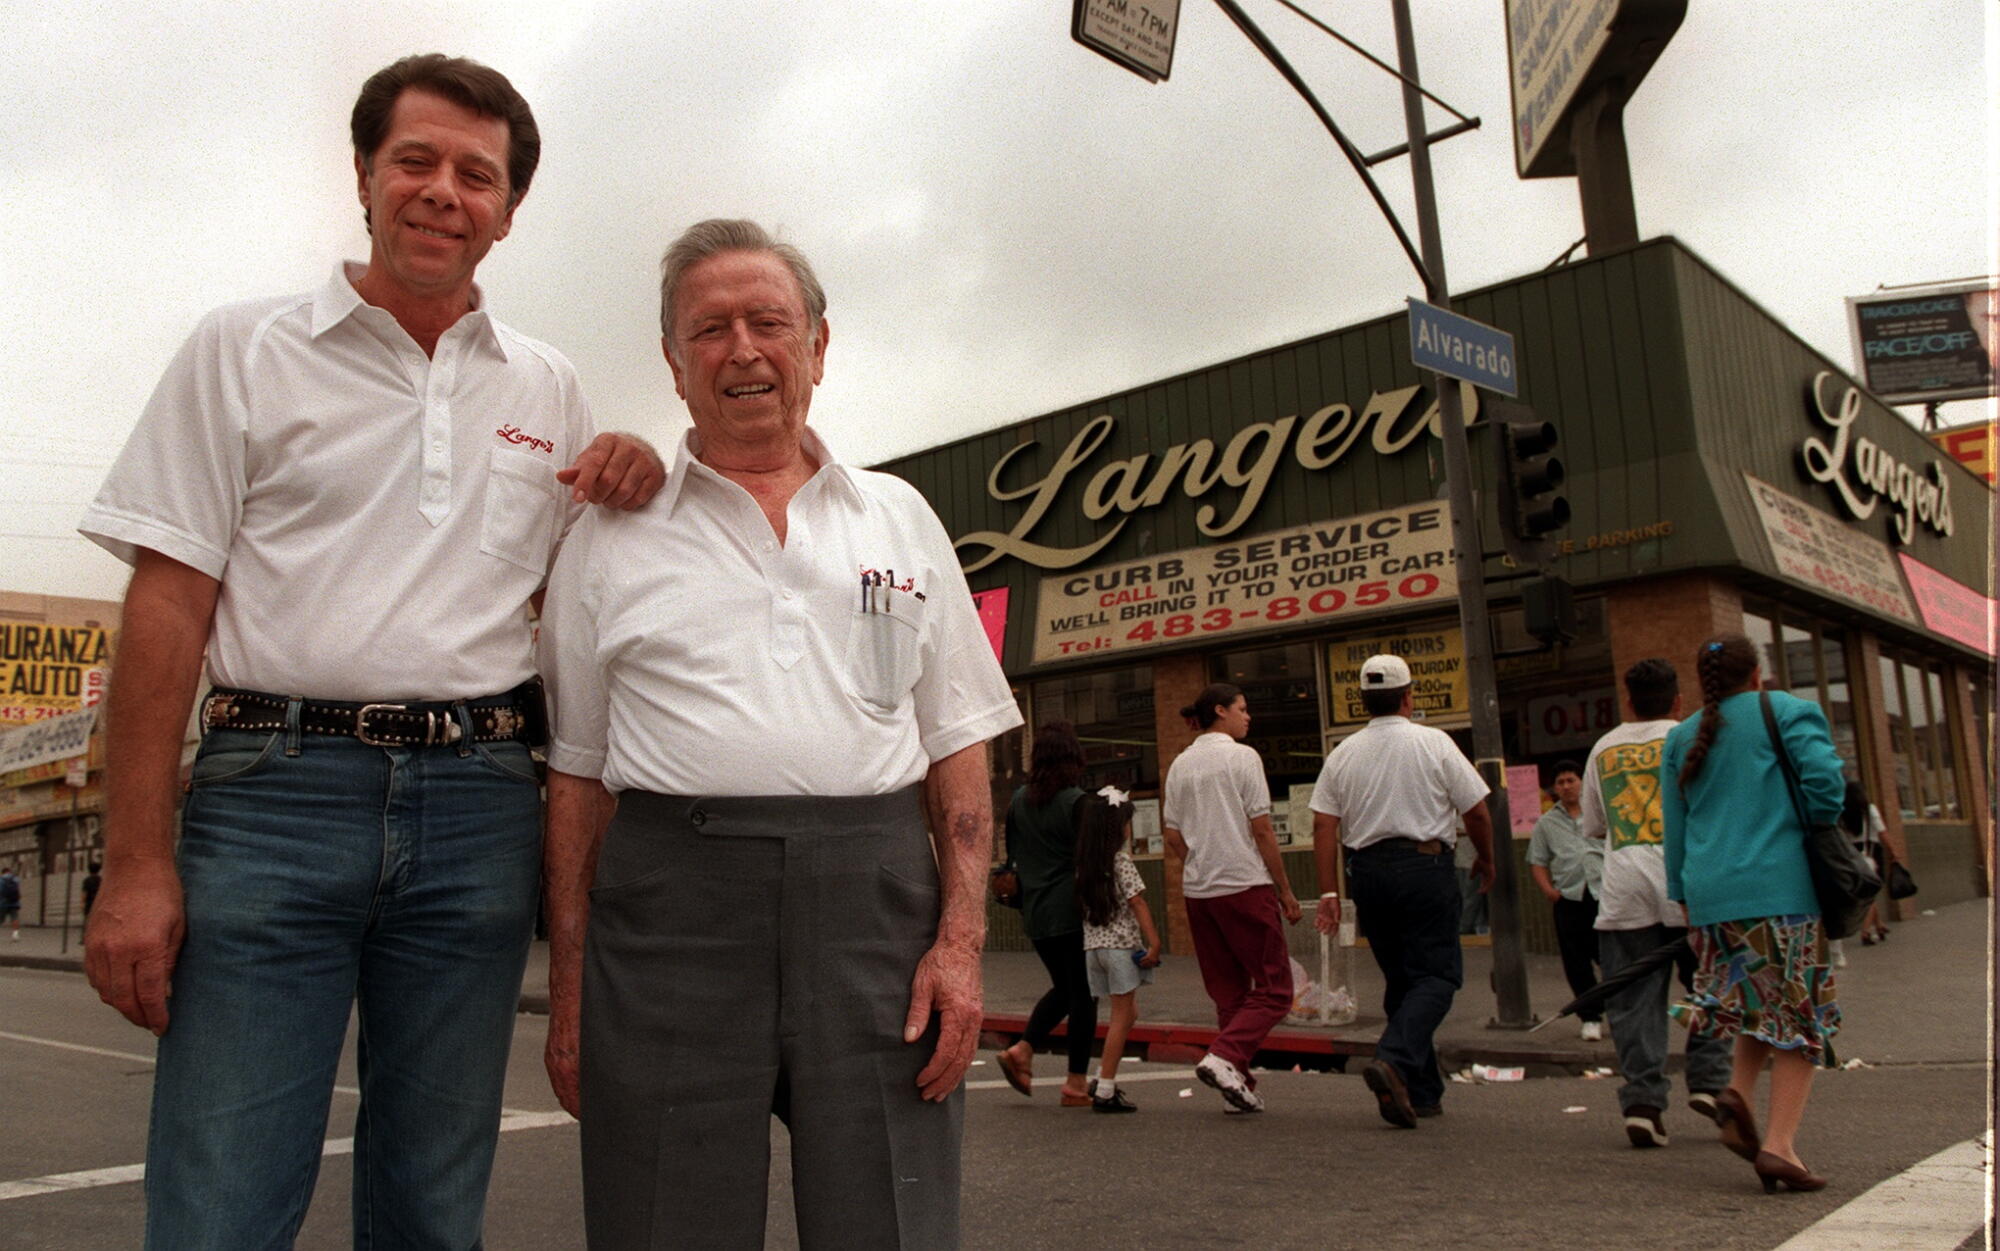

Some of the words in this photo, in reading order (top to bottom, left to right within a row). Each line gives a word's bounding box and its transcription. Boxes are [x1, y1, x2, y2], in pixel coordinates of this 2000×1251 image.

[1141, 6, 1150, 27] 7
[1149, 15, 1168, 38] PM
[1416, 317, 1511, 379] Alvarado
[1864, 330, 1975, 359] FACE/OFF
[953, 383, 1479, 574] Langers
[1803, 370, 1954, 545] Langer's
[1063, 559, 1185, 598] CURB
[1213, 509, 1441, 569] SERVICE
[1587, 520, 1674, 549] PARKING
[1050, 612, 1110, 634] WE'LL
[1119, 594, 1197, 622] BRING
[1207, 588, 1231, 607] IT
[1241, 578, 1275, 601] TO
[1289, 563, 1368, 592] YOUR
[1380, 548, 1457, 576] CAR!
[1100, 584, 1158, 608] CALL
[1168, 577, 1194, 594] IN
[1206, 562, 1280, 588] YOUR
[1290, 541, 1390, 572] ORDER
[1058, 636, 1114, 655] Tel:
[1125, 572, 1441, 643] 483-8050
[0, 623, 108, 665] URANZA
[1347, 641, 1382, 662] NEW
[1390, 636, 1446, 657] HOURS
[10, 664, 81, 697] AUTO
[1335, 671, 1361, 684] MON
[1409, 658, 1461, 675] ATURDAY
[1600, 746, 1664, 773] LEO
